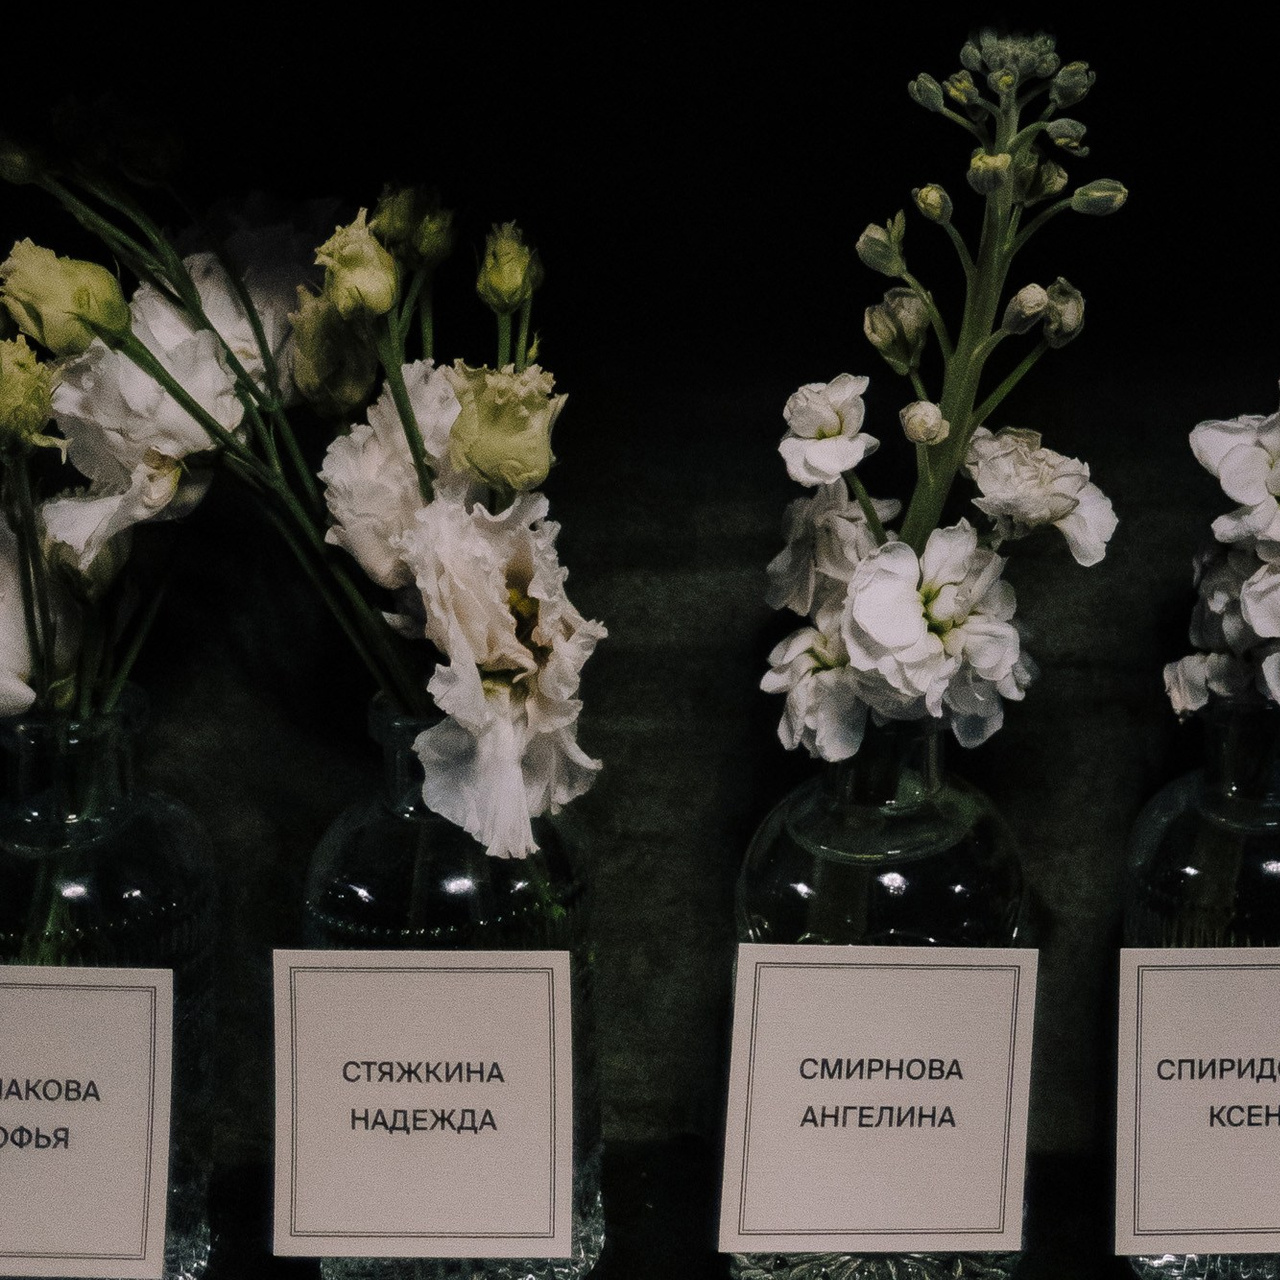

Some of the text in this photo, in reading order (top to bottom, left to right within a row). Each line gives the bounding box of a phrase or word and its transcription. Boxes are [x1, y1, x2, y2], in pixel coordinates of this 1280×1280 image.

[342, 1060, 506, 1084] СТЯЖКИНА
[799, 1057, 964, 1081] СМИРНОВА
[0, 1077, 101, 1102] АКОВА
[350, 1108, 498, 1136] НАДЕЖДА
[799, 1105, 956, 1128] АНГЕЛИНА
